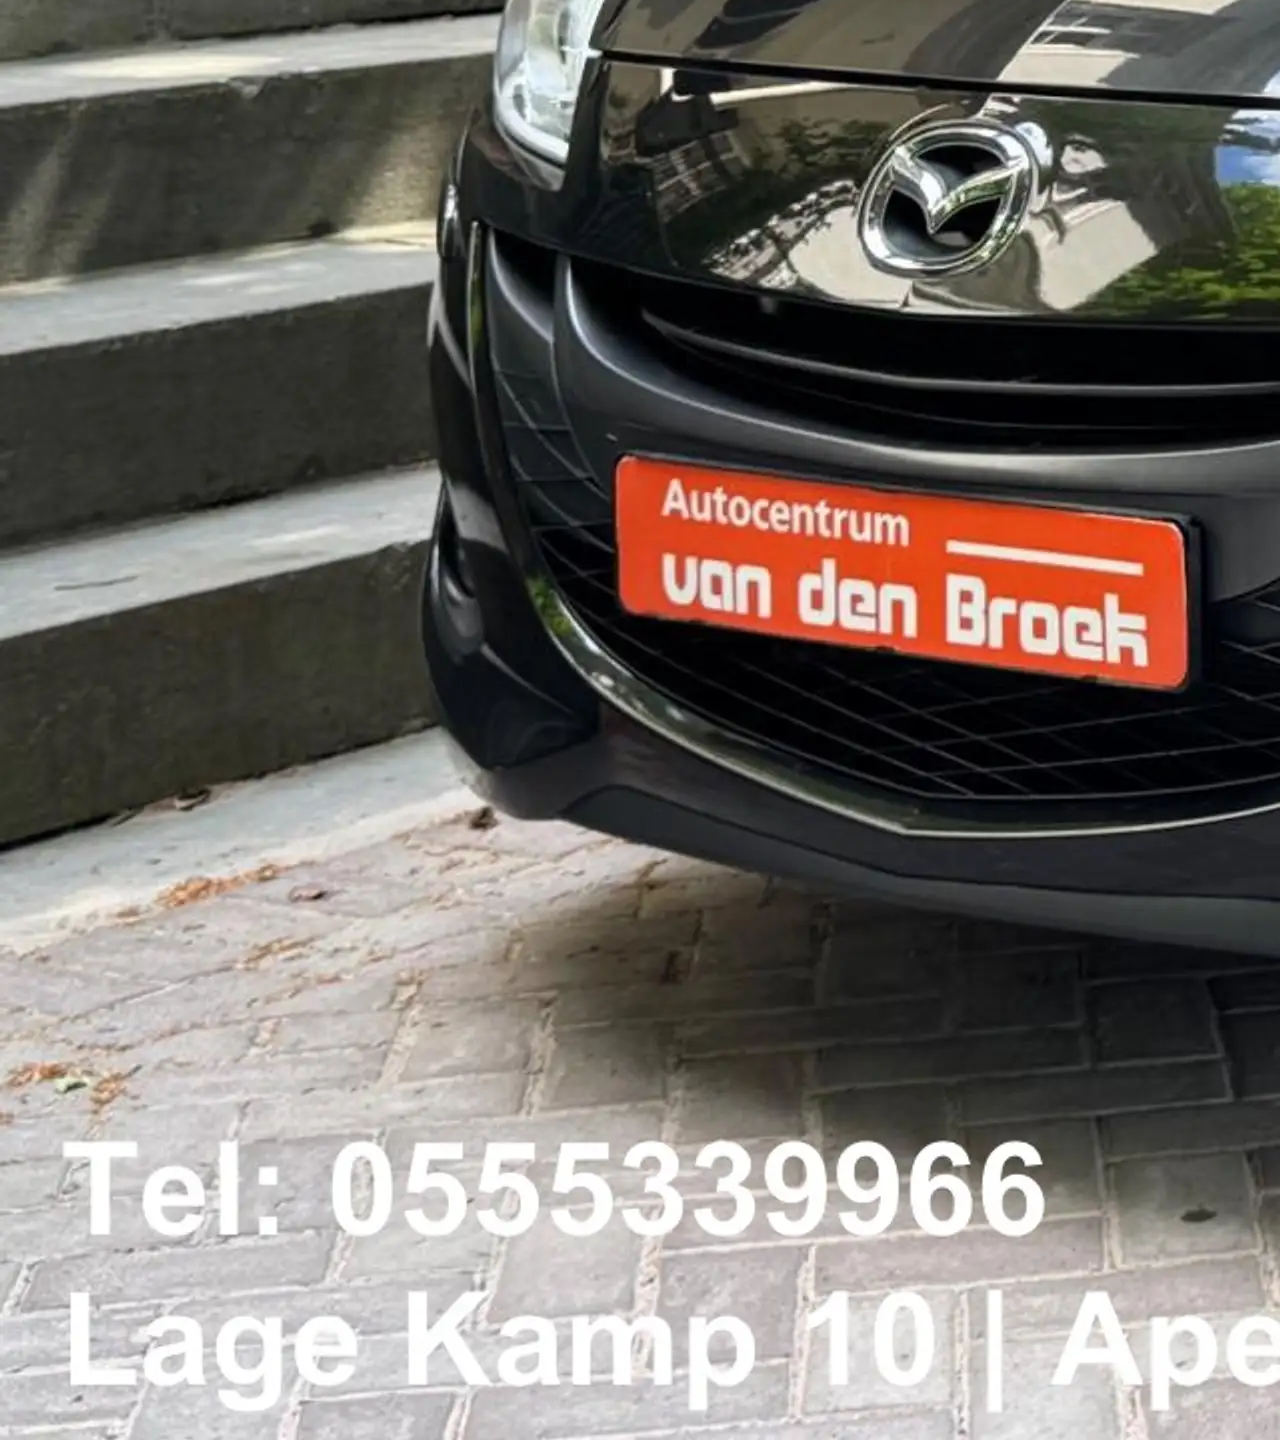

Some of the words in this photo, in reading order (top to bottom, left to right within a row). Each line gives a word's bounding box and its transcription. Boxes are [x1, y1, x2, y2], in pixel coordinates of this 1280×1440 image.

[661, 478, 910, 547] Autocentrum
[662, 552, 772, 619] van
[797, 558, 918, 639] den
[945, 572, 1149, 668] Broek
